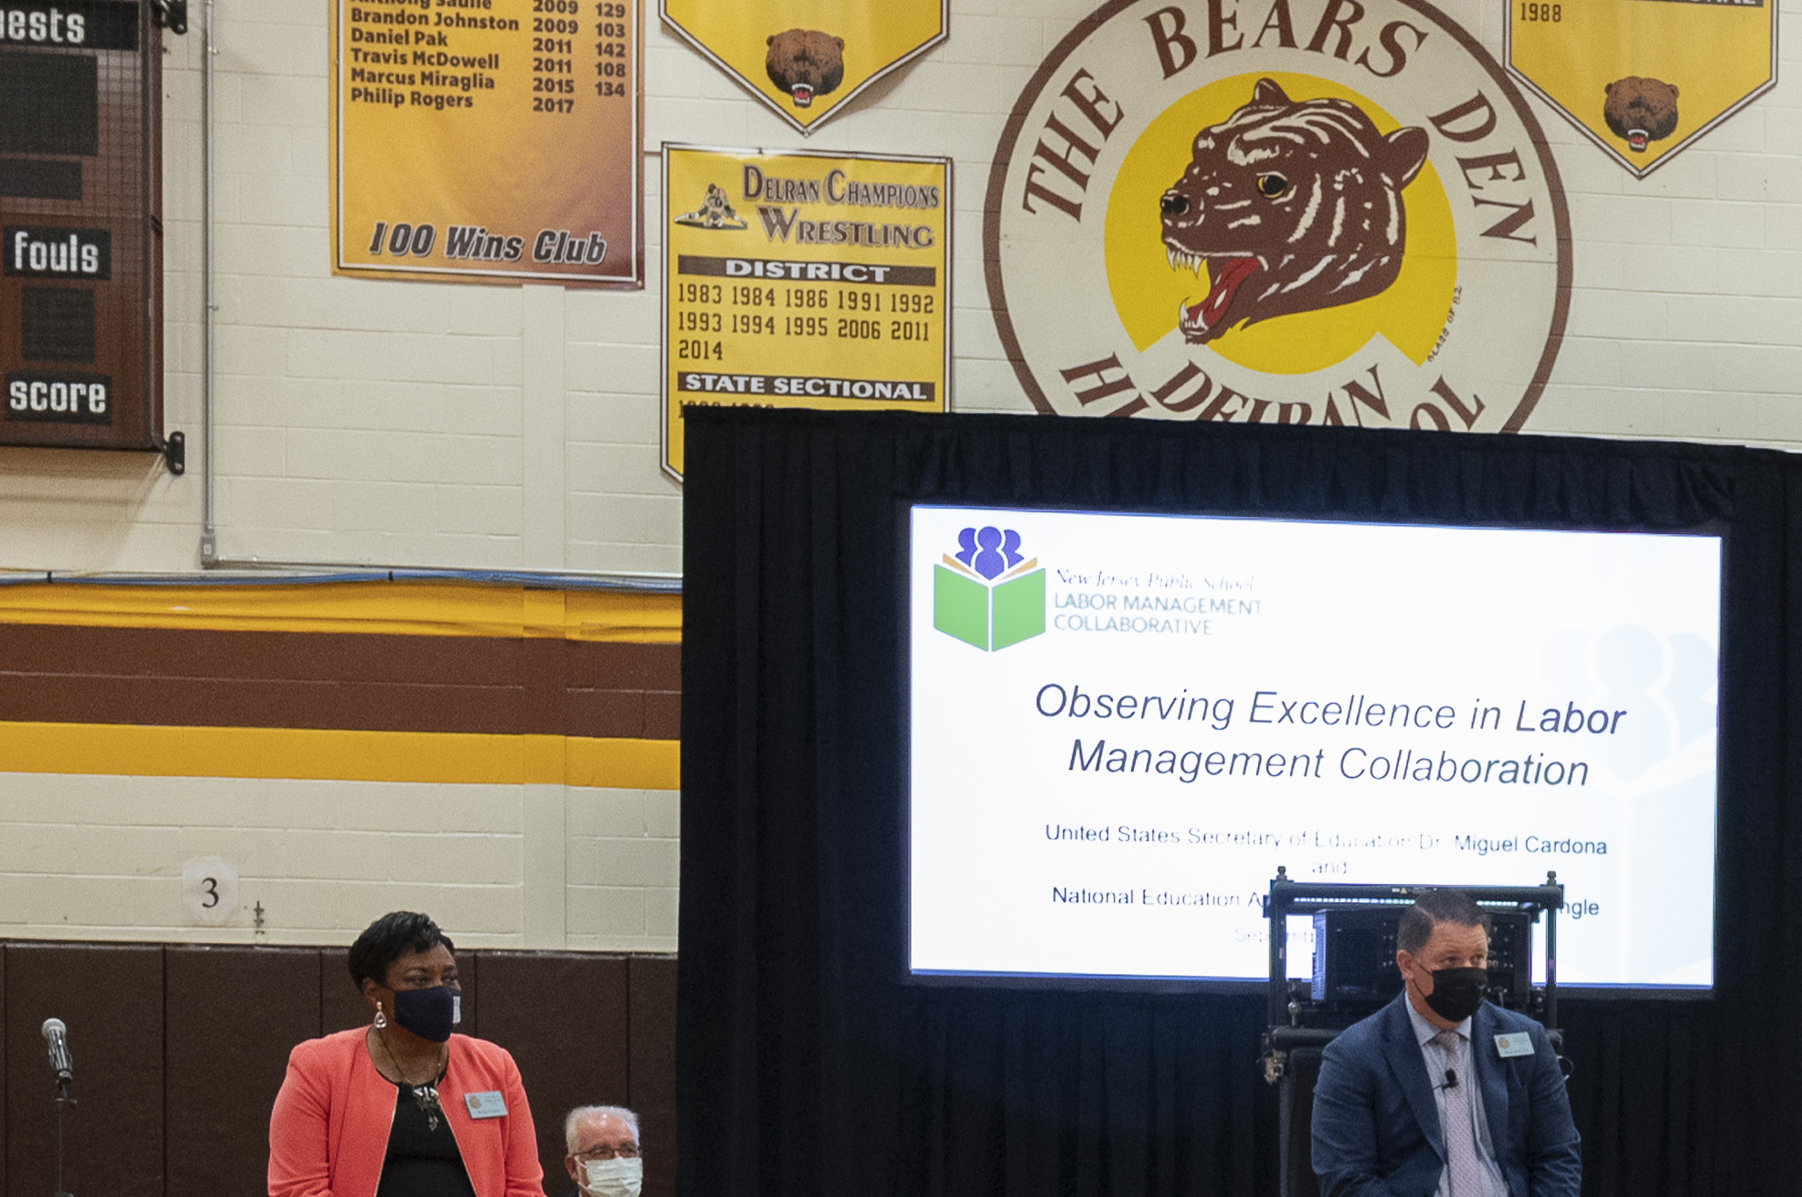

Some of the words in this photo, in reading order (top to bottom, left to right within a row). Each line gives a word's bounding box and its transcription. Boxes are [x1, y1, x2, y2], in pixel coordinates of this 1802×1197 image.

[351, 7, 429, 25] Brandon
[434, 11, 519, 31] Johnston
[533, 17, 579, 35] 2009
[595, 22, 626, 38] 103
[533, 0, 579, 14] 2009
[595, 2, 626, 18] 129
[1520, 2, 1562, 23] 1988
[0, 8, 85, 43] ests
[351, 27, 409, 45] Daniel
[414, 30, 448, 47] Pak
[533, 37, 572, 54] 2011
[595, 41, 626, 58] 142
[350, 48, 407, 66] Travis
[412, 51, 500, 70] McDowell
[533, 57, 573, 74] 2011
[595, 61, 626, 78] 108
[351, 68, 416, 86] Marcus
[420, 71, 495, 91] Miraglia
[533, 77, 575, 93] 2015
[595, 81, 626, 98] 134
[351, 87, 405, 108] Philip
[410, 91, 474, 110] Rogers
[533, 97, 575, 113] 2017
[1022, 67, 1125, 224] THE
[1142, 0, 1429, 80] BEARS
[1427, 89, 1538, 248] DEN
[825, 168, 941, 210] CHAMPIONS
[756, 205, 935, 249] WRESTLING
[13, 231, 101, 275] fouls
[369, 222, 436, 257] 100
[444, 225, 523, 262] Wins
[532, 230, 608, 267] Club
[725, 259, 890, 283] DISTRICT
[678, 282, 722, 305] 1983
[732, 286, 775, 307] 1984
[785, 288, 828, 308] 1986
[838, 290, 881, 312] 1991
[891, 293, 934, 314] 1992
[678, 311, 722, 332] 1993
[732, 314, 775, 335] 1994
[785, 316, 828, 337] 1995
[838, 318, 881, 340] 2006
[891, 321, 929, 341] 2011
[678, 339, 723, 360] 2014
[9, 378, 106, 414] score
[685, 374, 765, 393] STATE
[774, 377, 927, 400] SECTIONAL
[1055, 568, 1092, 585] New
[1095, 569, 1141, 590] Jersey
[1146, 572, 1196, 590] Public
[1054, 592, 1118, 610] LABOR
[1122, 595, 1262, 615] MANAGEMENT
[1053, 613, 1213, 635] COLLABORATIVE
[1035, 683, 1235, 730] Observing
[1249, 690, 1456, 729] Excellence
[1470, 698, 1502, 731] in
[1515, 700, 1628, 735] Labor
[1068, 739, 1324, 783] Management
[1339, 747, 1590, 786] Collaboration
[1045, 824, 1110, 843] United
[1117, 826, 1180, 845] States
[1187, 828, 1281, 851] Secretary
[1289, 830, 1308, 847] of
[1454, 834, 1520, 857] Miguel
[1525, 836, 1608, 856] Cardona
[1312, 858, 1348, 876] and
[201, 877, 220, 908] 3
[1052, 887, 1135, 906] National
[1142, 889, 1241, 908] Education
